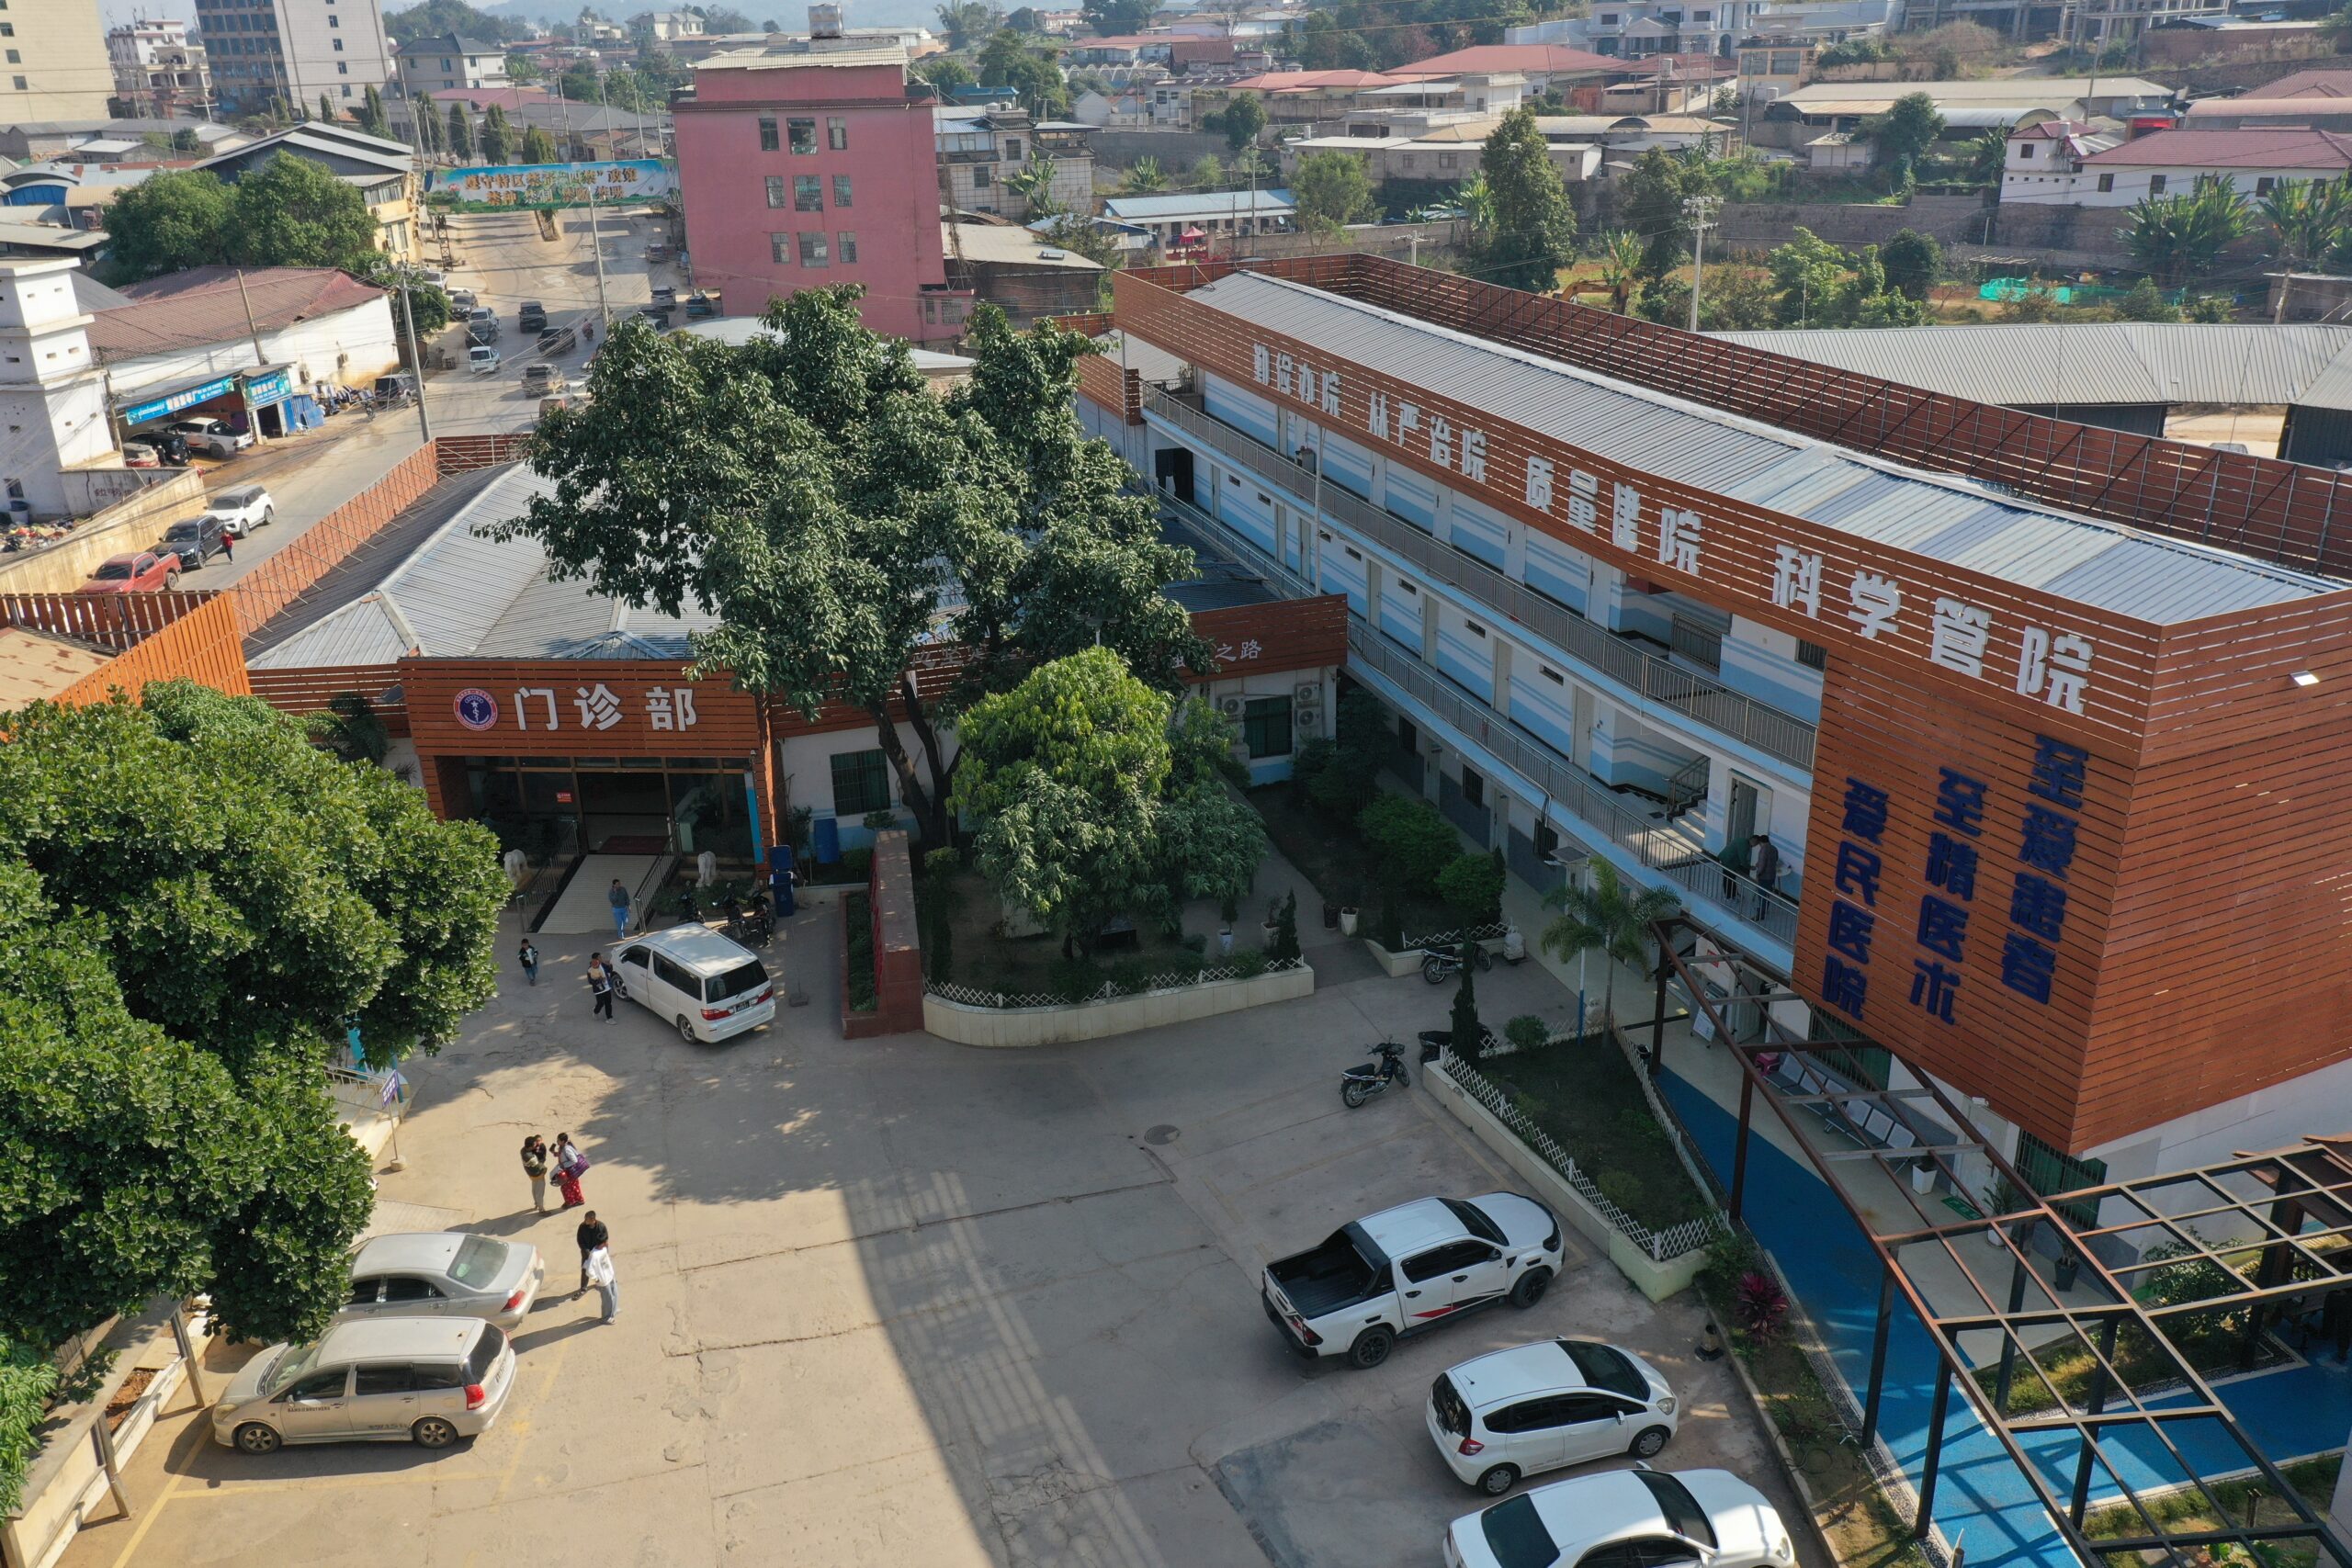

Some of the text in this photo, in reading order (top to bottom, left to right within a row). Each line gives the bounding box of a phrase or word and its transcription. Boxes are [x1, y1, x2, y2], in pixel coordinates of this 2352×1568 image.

[1369, 390, 1487, 483] 从严治院
[1526, 456, 1702, 575] 质量建院
[1772, 544, 2093, 715] 科学管院
[514, 683, 697, 731] 门诊部
[1822, 776, 1889, 1021] 爱民医院
[1909, 766, 1987, 1026] 至精医术
